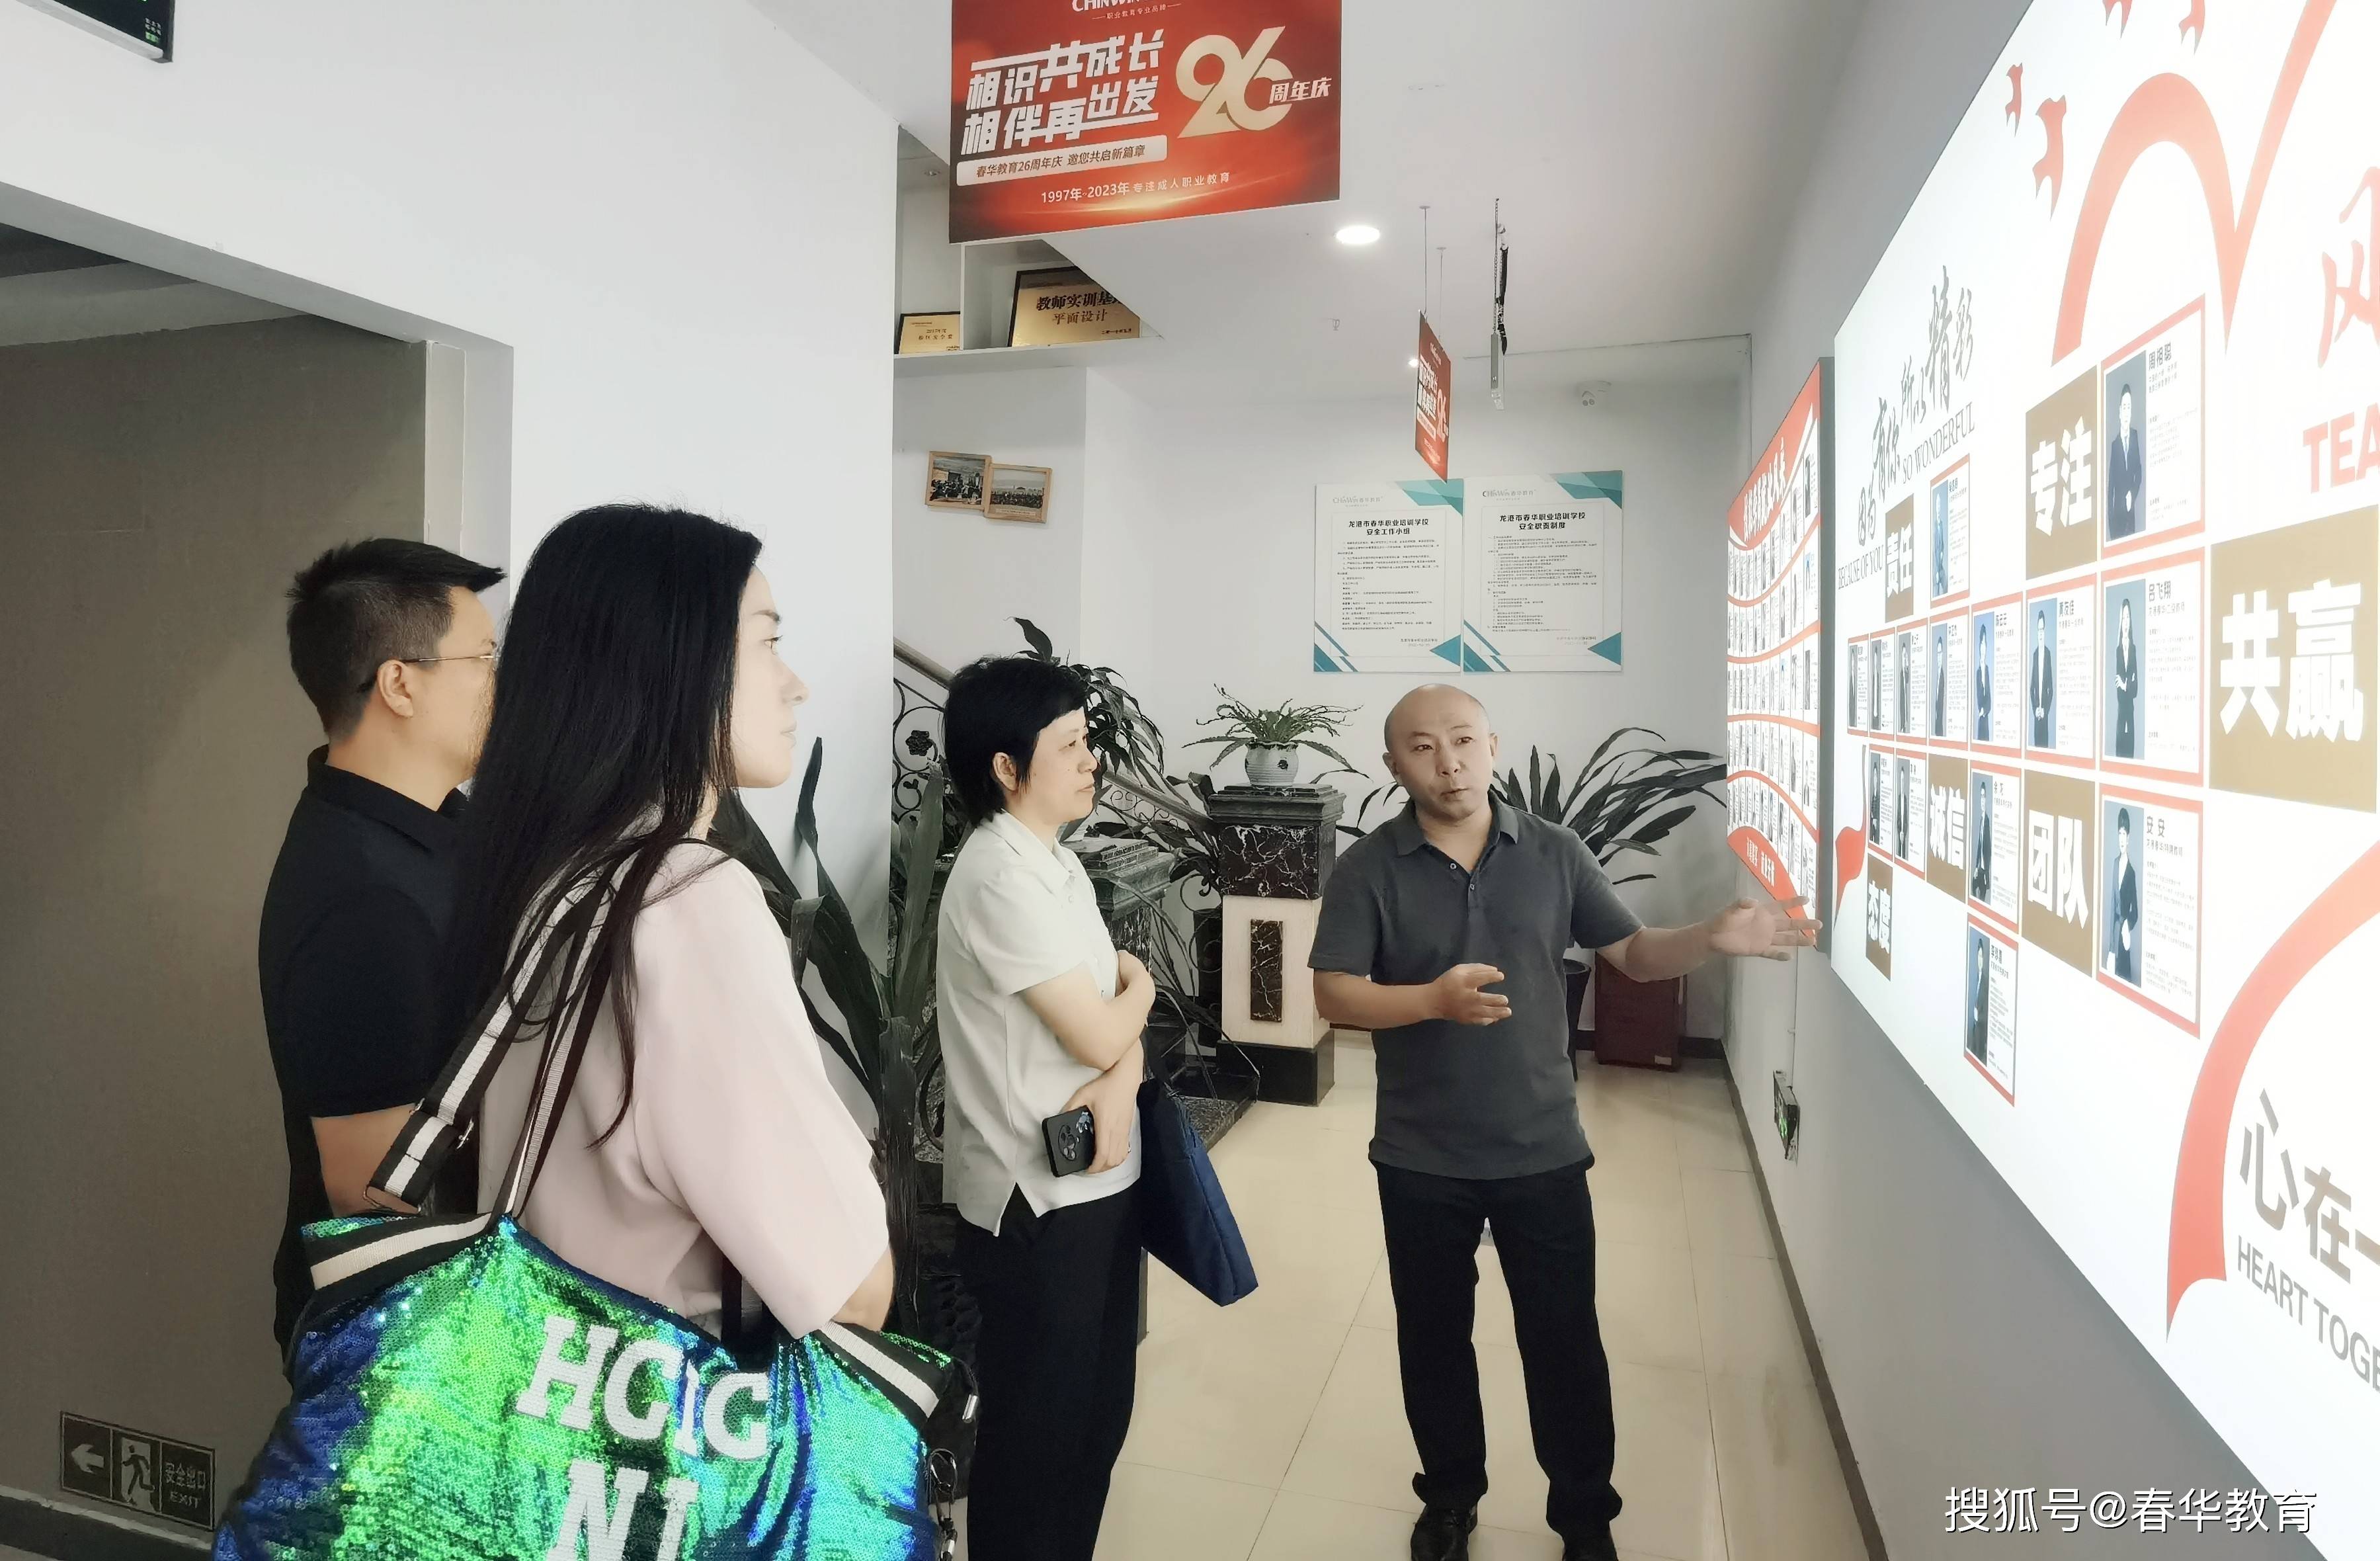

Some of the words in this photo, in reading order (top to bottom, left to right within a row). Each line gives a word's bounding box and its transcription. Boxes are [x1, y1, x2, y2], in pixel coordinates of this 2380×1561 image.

[966, 29, 1164, 110] 相识共成长
[1269, 77, 1332, 105] 周年庆
[961, 75, 1159, 155] 相伴再出发
[976, 156, 1063, 178] 春华教育26周年庆
[1067, 145, 1145, 165] 邀您共启新篇章
[1053, 309, 1108, 325] 平面设计
[1903, 454, 1912, 484] SO
[1914, 402, 1975, 472] WONDERFUL
[2030, 416, 2092, 536] 专注
[1348, 518, 1429, 528] 龙港市春华职业培训学校
[1366, 527, 1410, 536] 安全工作小组
[1500, 511, 1586, 523] 龙港市春华职业培训学校
[1838, 558, 1860, 590] BECAUSE
[1861, 554, 1868, 579] OF
[1869, 544, 1883, 574] YOU
[1887, 523, 1912, 598] 责任
[2220, 579, 2364, 743] 共赢
[1930, 783, 1965, 870] 诚信
[2028, 810, 2088, 929] 团队
[1867, 880, 1891, 954] 态度
[2238, 1235, 2309, 1326] HEART
[165, 1461, 206, 1489] 安全出口
[170, 1491, 201, 1509] EXIT
